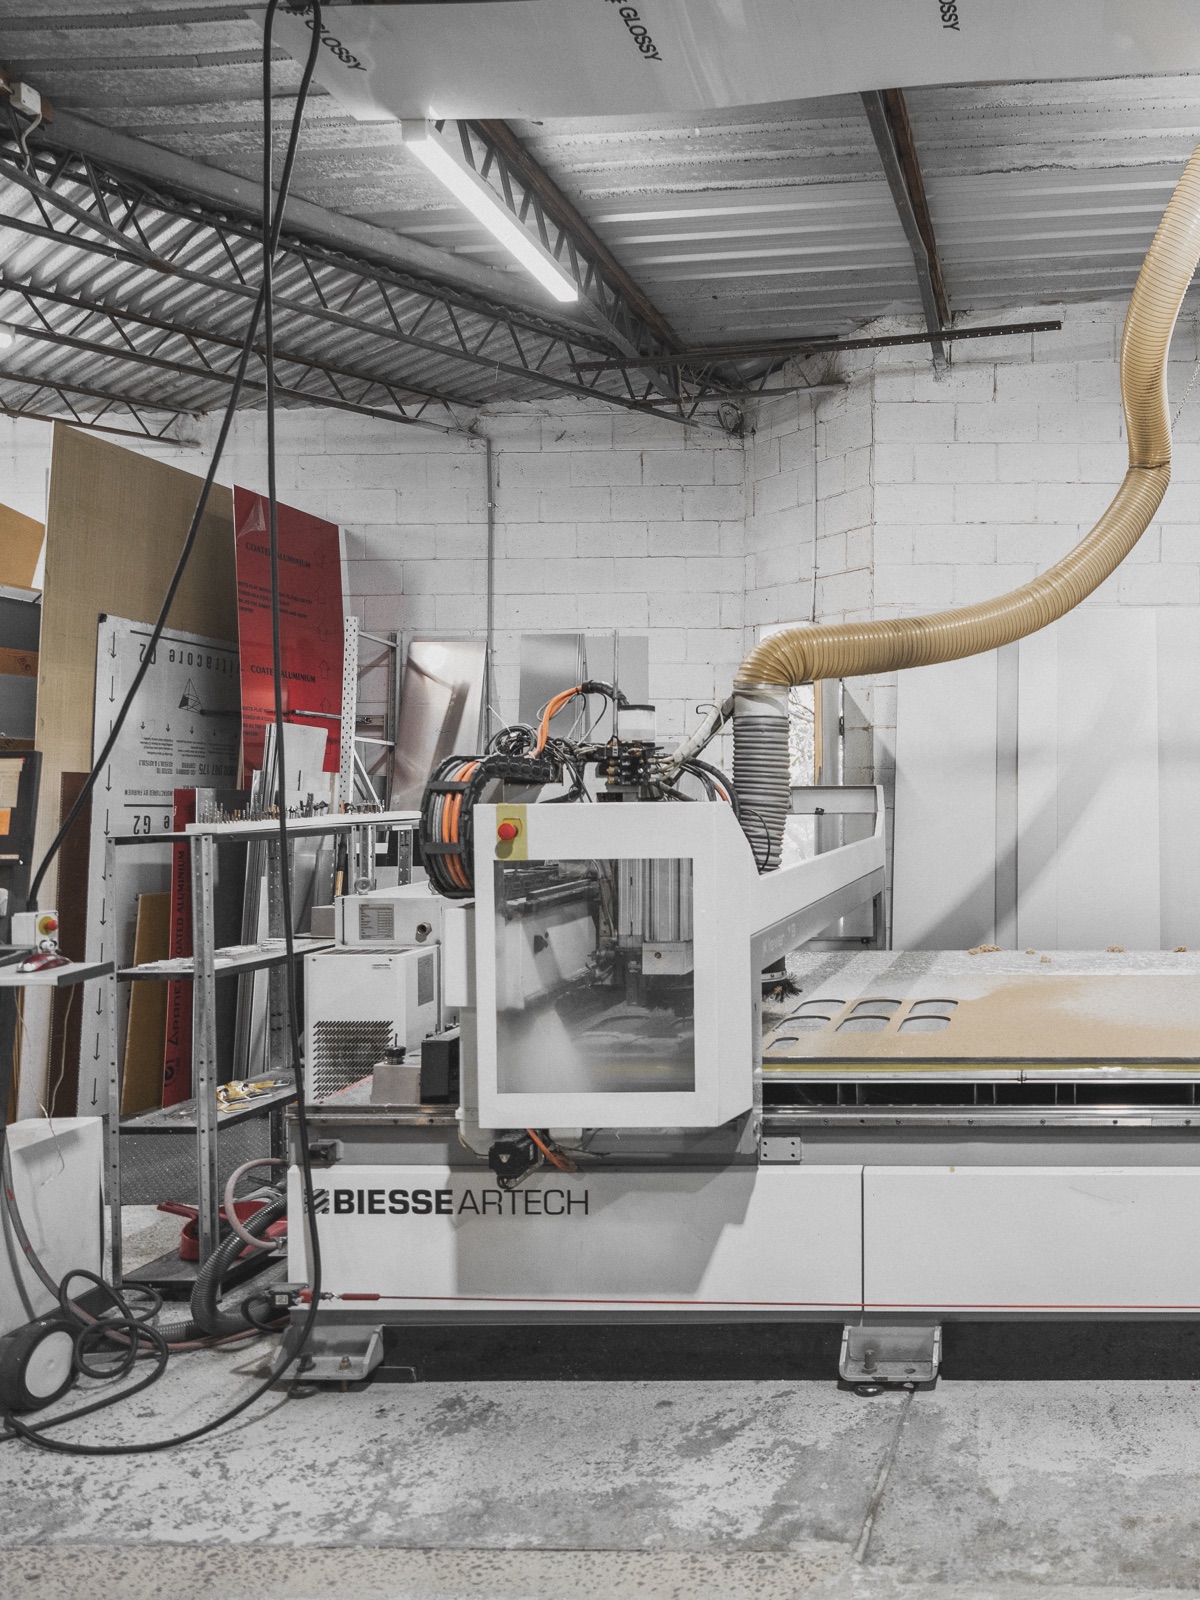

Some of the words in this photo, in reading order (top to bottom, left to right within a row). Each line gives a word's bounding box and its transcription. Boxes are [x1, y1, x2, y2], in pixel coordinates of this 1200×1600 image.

[619, 7, 663, 61] GLOSSY
[305, 20, 367, 72] GOSSY
[245, 541, 272, 558] COATE
[250, 664, 274, 676] COATE
[133, 815, 151, 835] G2
